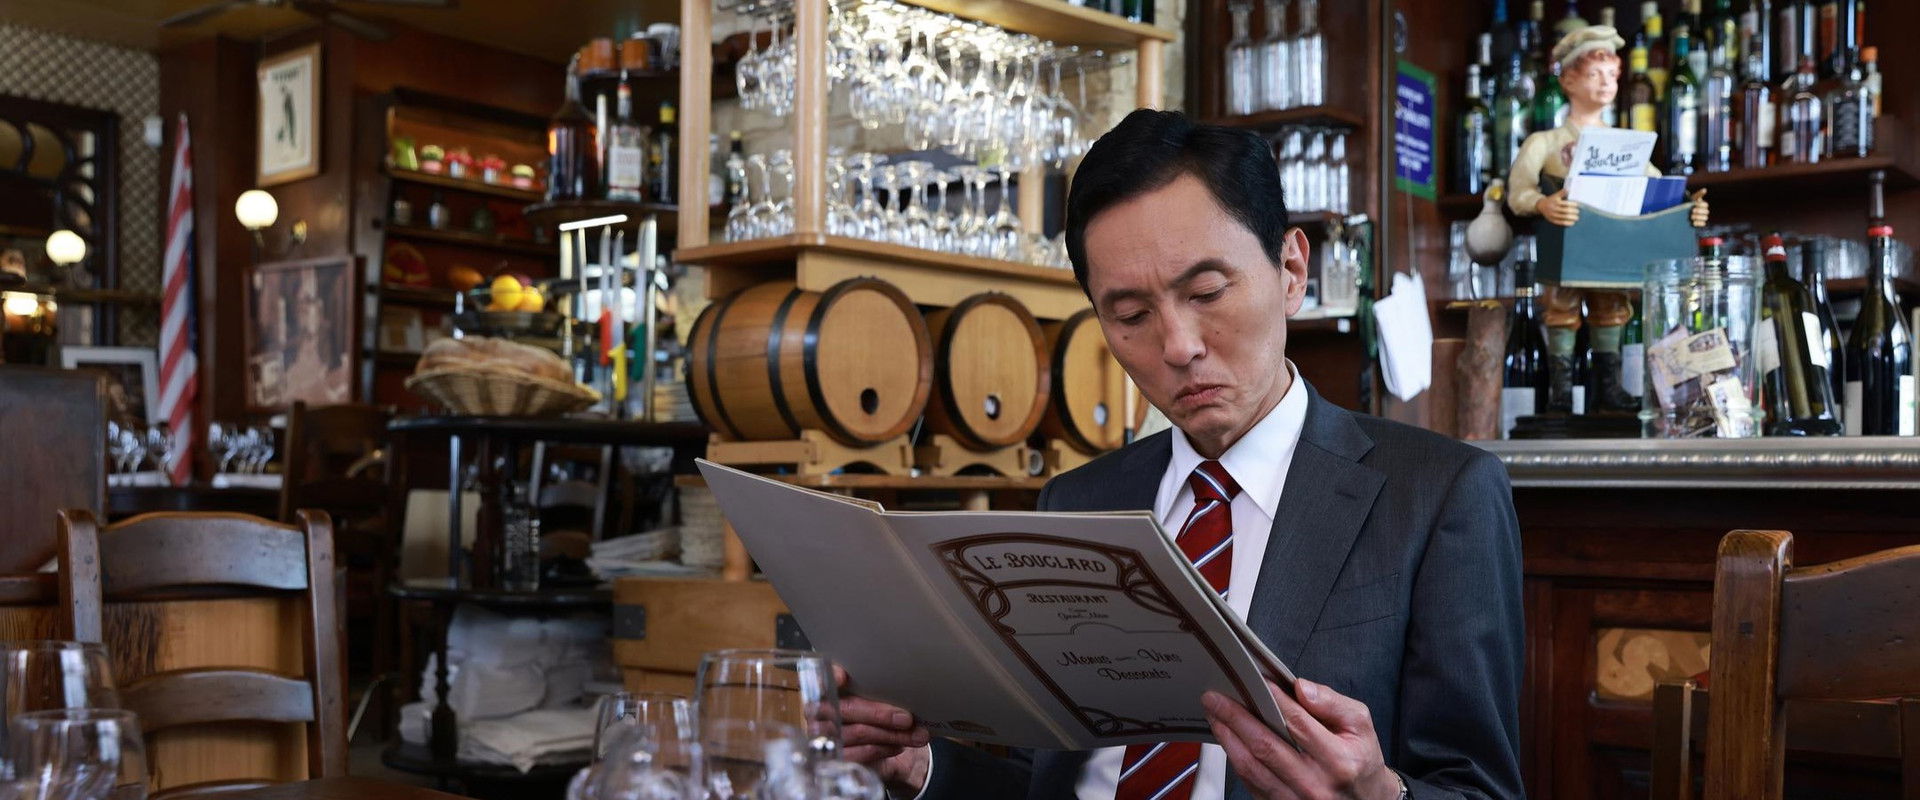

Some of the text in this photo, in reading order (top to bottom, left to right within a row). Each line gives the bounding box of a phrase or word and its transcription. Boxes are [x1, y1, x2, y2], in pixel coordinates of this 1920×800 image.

[973, 552, 1107, 573] LE BOUCLARD
[1026, 592, 1109, 604] RESTAURANT
[1056, 648, 1182, 666] Menus Vins
[1097, 667, 1172, 681] Desserts
